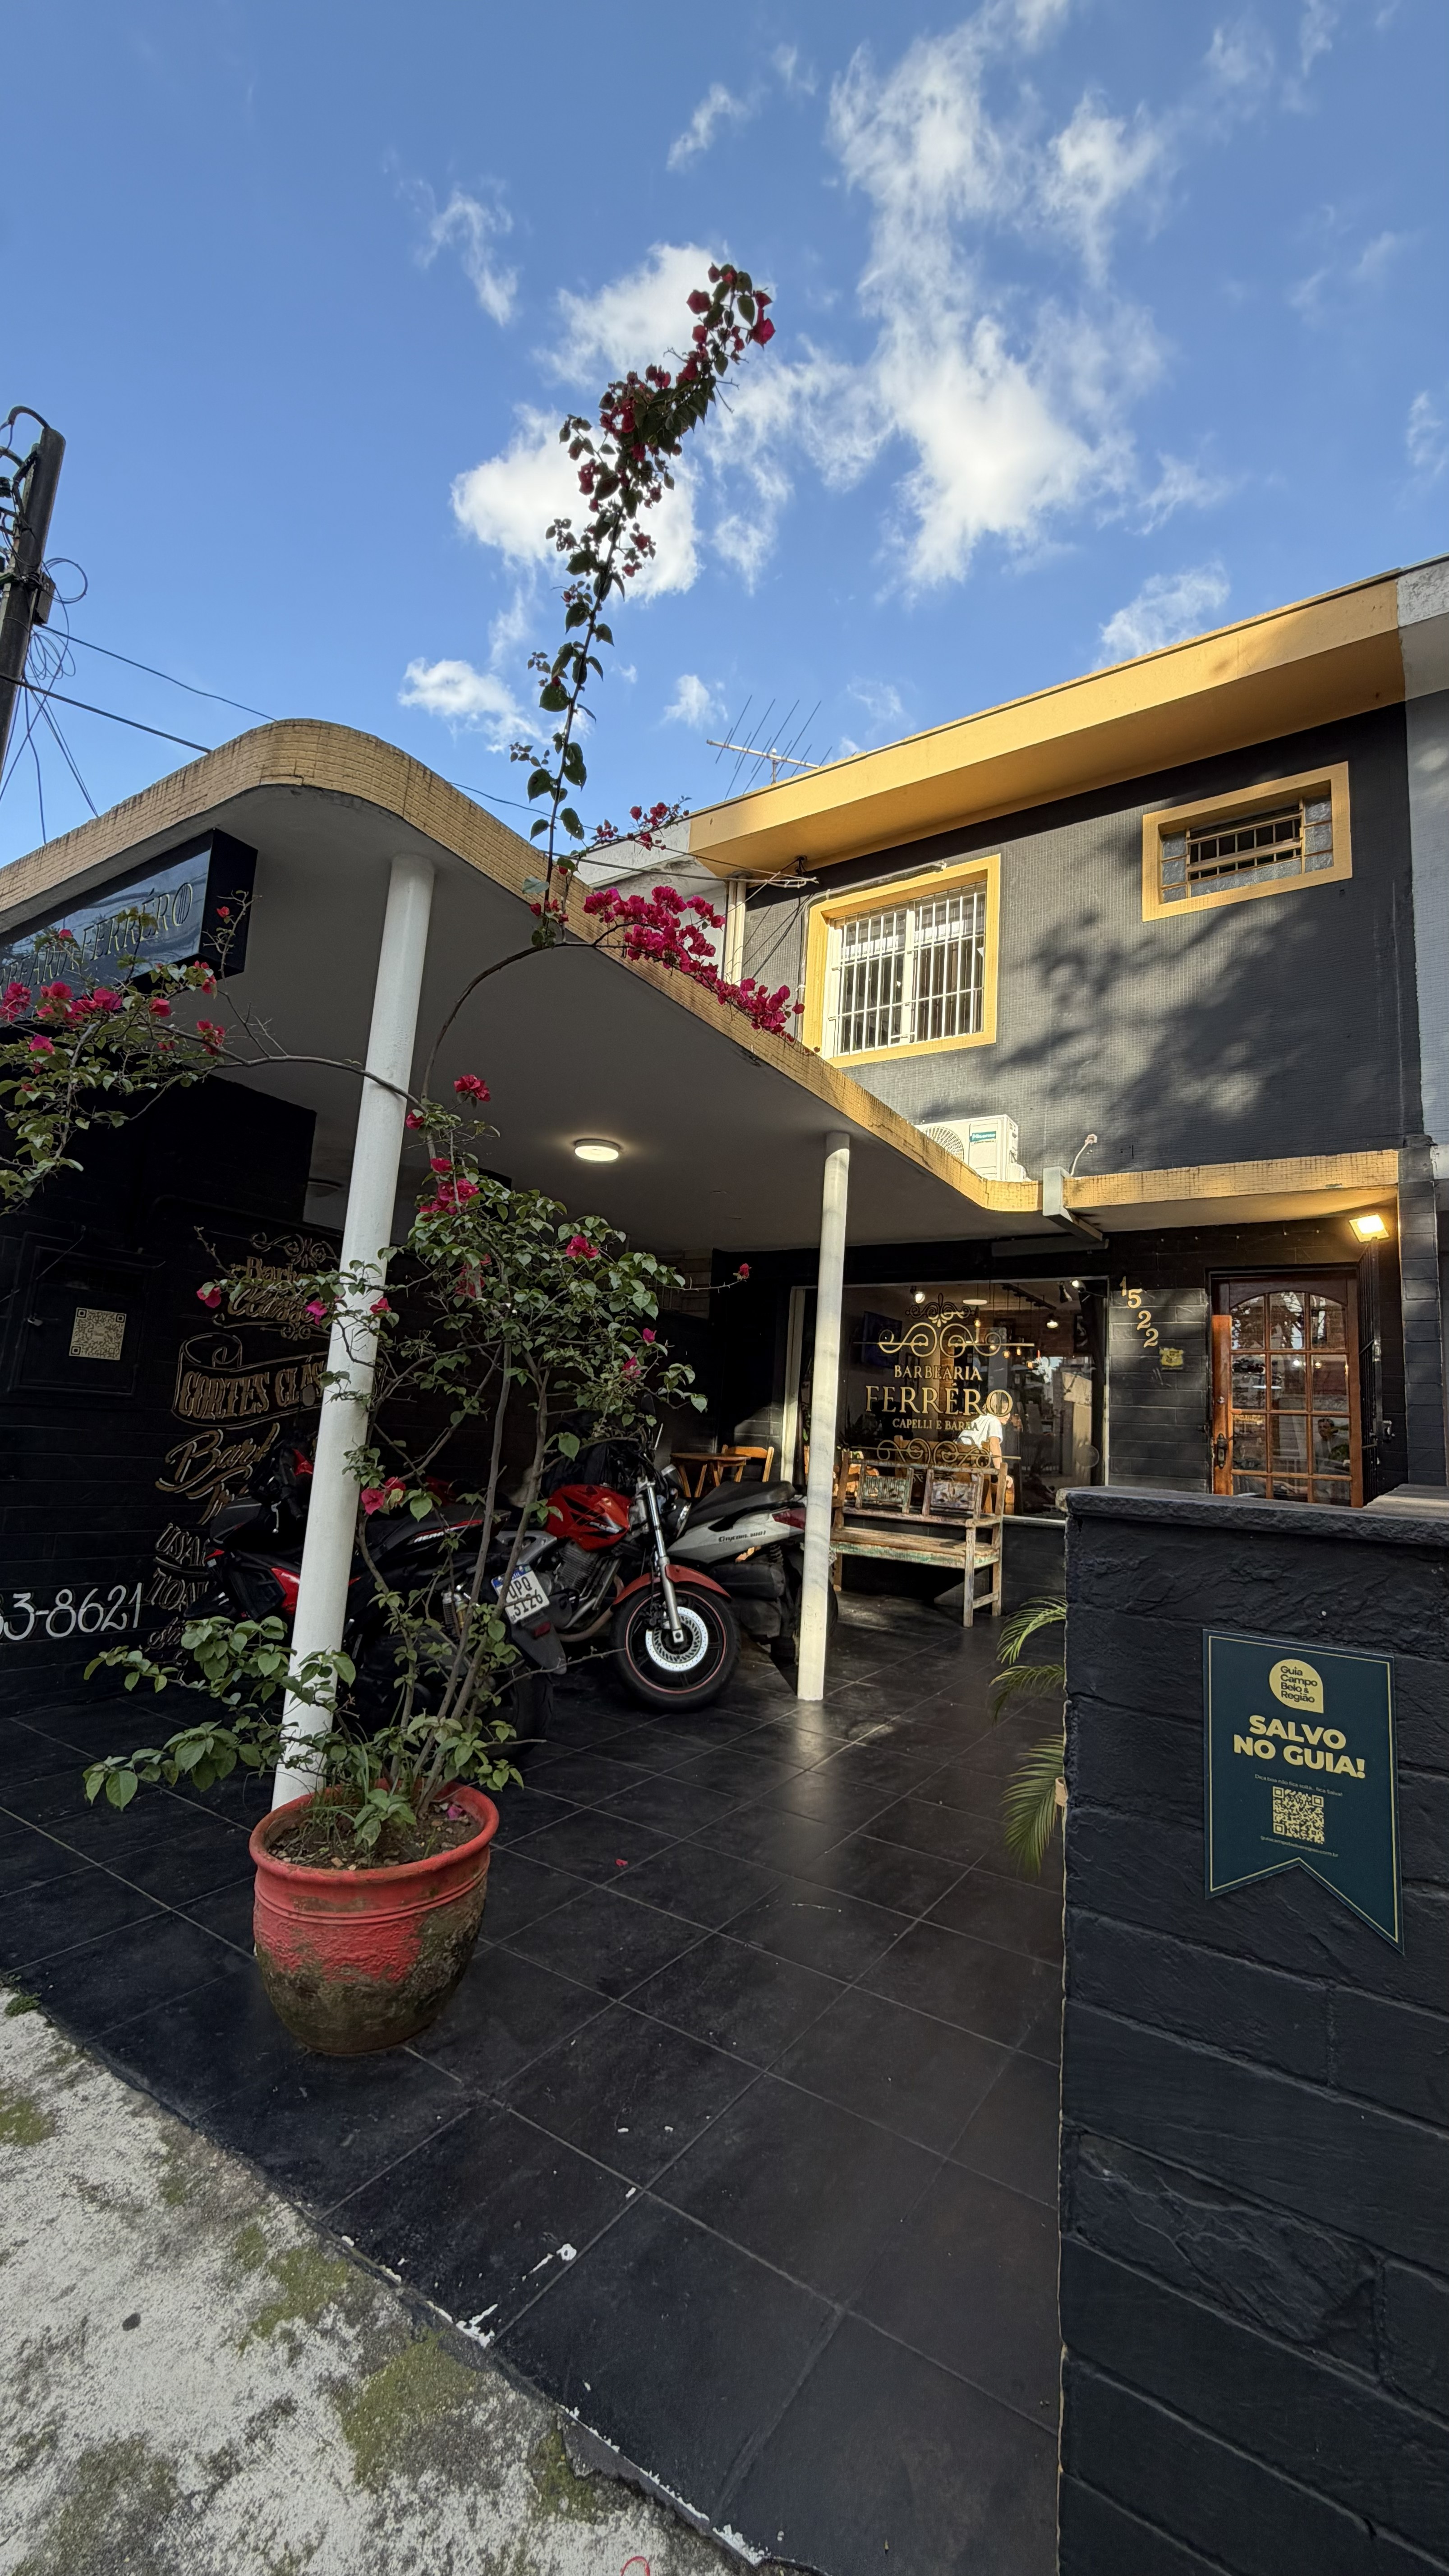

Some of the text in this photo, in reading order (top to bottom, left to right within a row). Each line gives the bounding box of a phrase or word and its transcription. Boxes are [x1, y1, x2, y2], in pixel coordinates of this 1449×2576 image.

[1119, 1276, 1159, 1348] 1522
[894, 1365, 983, 1381] BARBEARIA
[179, 1370, 270, 1420] CORTES
[892, 1418, 932, 1429] CAPELLI
[936, 1420, 942, 1430] E
[0, 1582, 143, 1641] 3-8621
[1280, 1666, 1302, 1676] Guia
[1280, 1674, 1317, 1687] Campo
[1281, 1682, 1302, 1693] Belo
[1281, 1692, 1315, 1703] Região
[1249, 1715, 1346, 1749] SALVO
[1234, 1734, 1365, 1778] NO GUIA!
